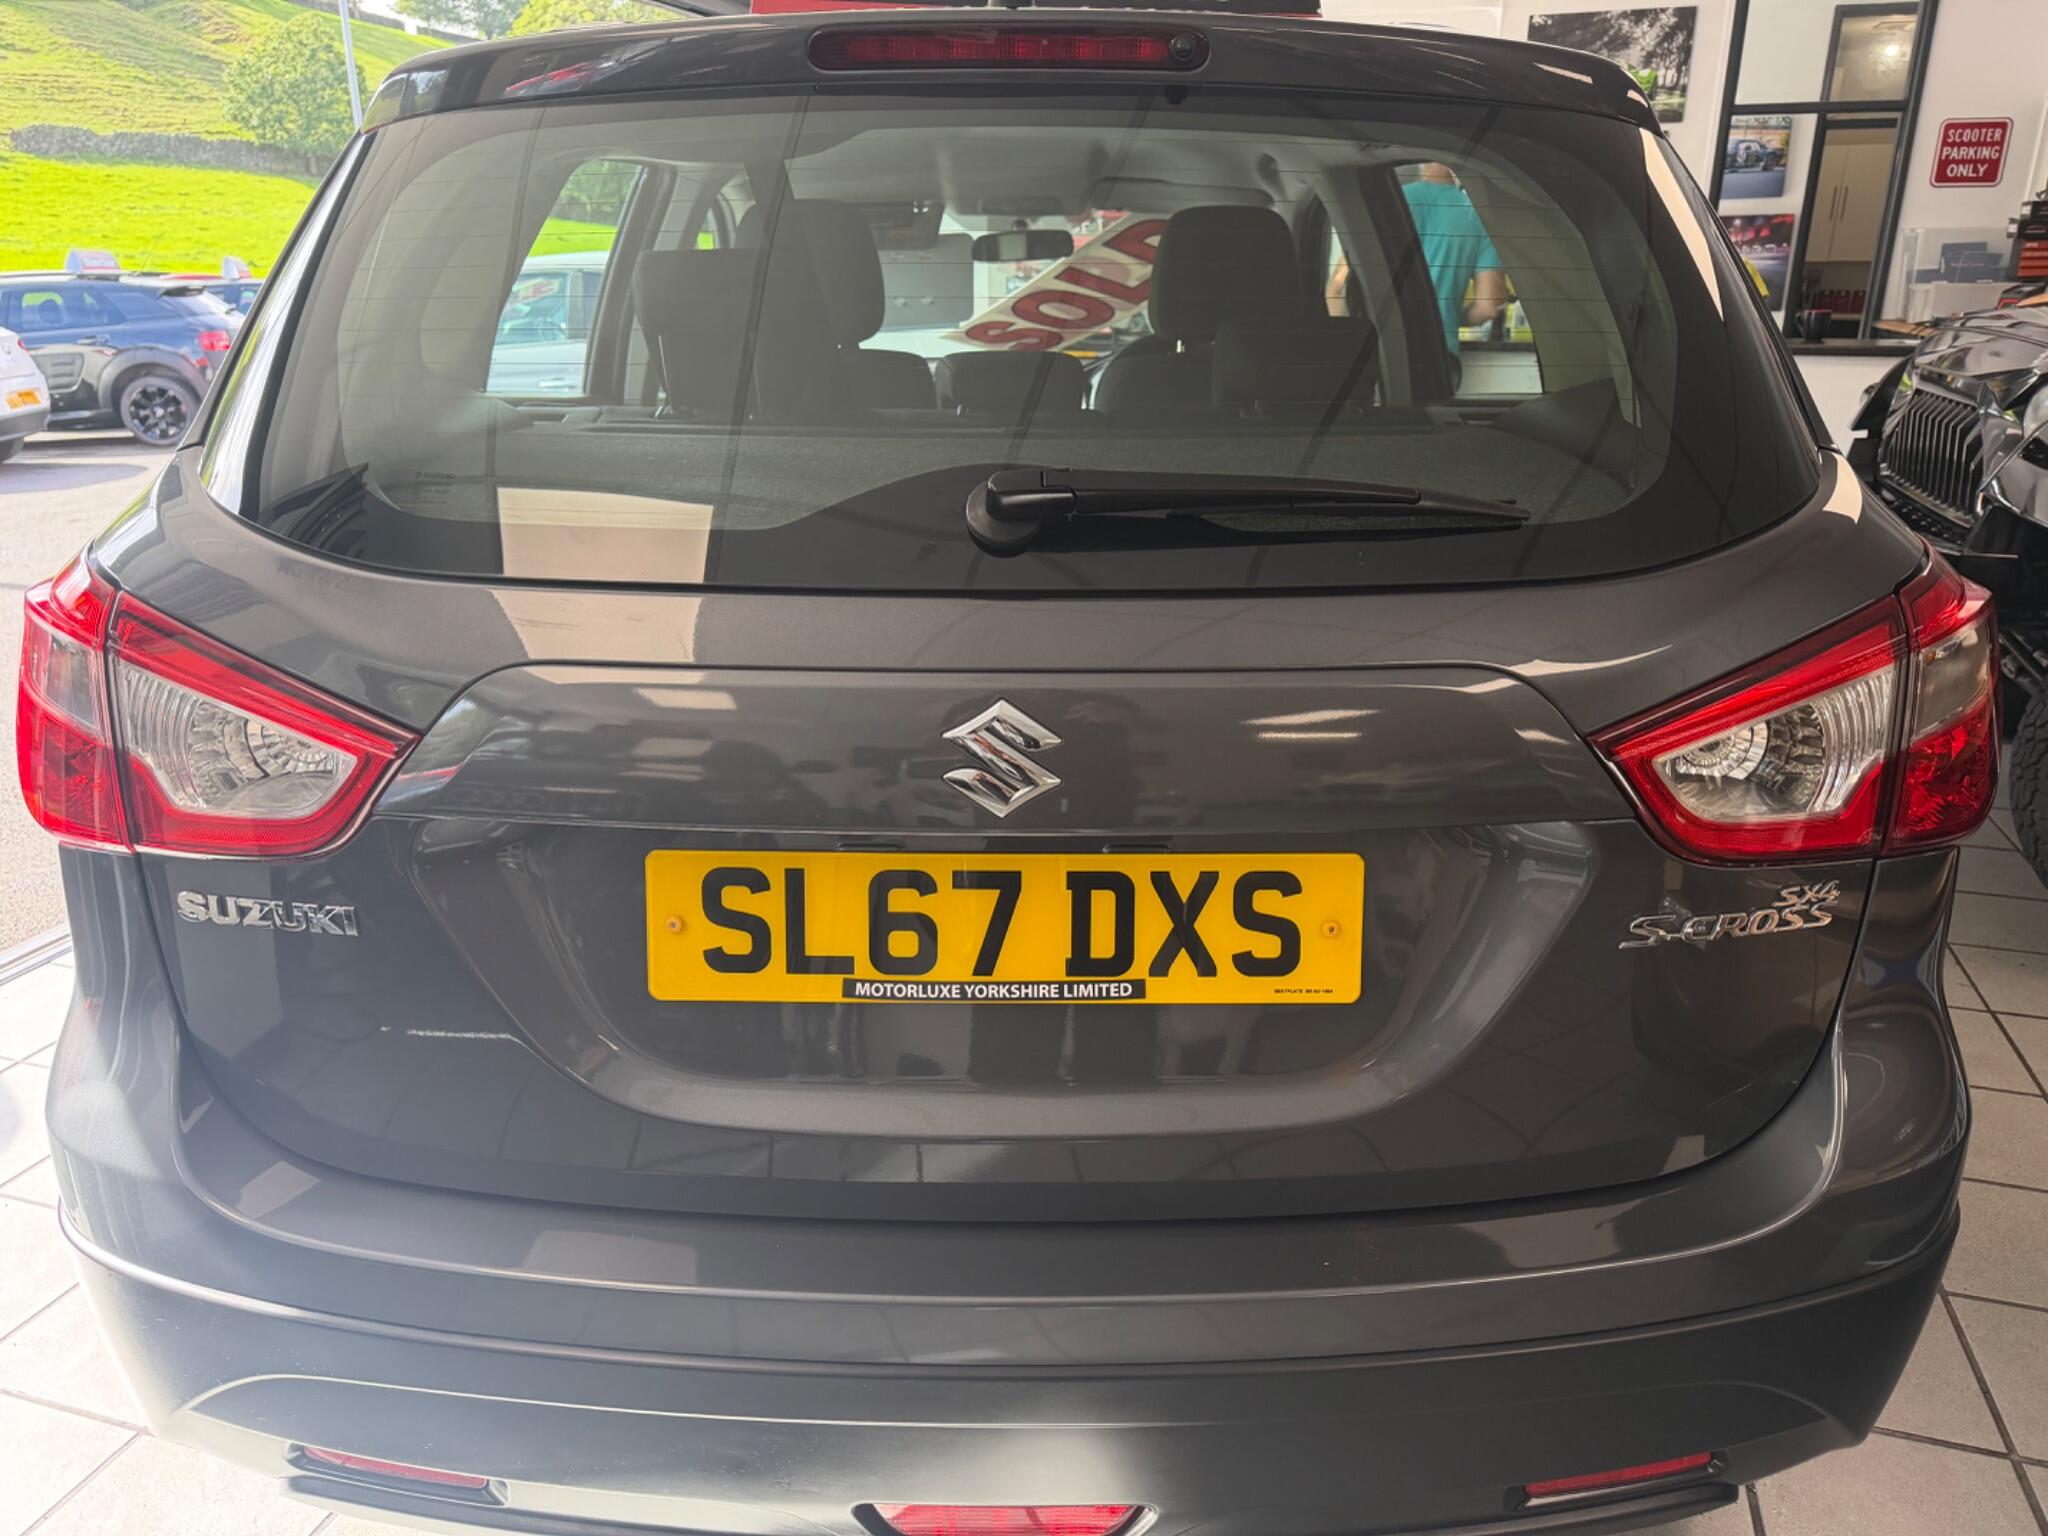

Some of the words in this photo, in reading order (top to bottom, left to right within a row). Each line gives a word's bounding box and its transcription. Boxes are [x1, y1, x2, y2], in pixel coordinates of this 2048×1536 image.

[1946, 128, 2002, 142] SCOOTER
[1941, 146, 2001, 160] PARKING
[1946, 163, 1988, 177] ONLY
[1772, 880, 1840, 906] SX4
[177, 890, 358, 937] SUZUKI
[701, 867, 1022, 977] SL67
[1065, 871, 1303, 978] DXS
[855, 981, 961, 998] MOTORLUXE
[964, 982, 1060, 998] YORKSHIRE
[1063, 982, 1133, 998] LIMITED
